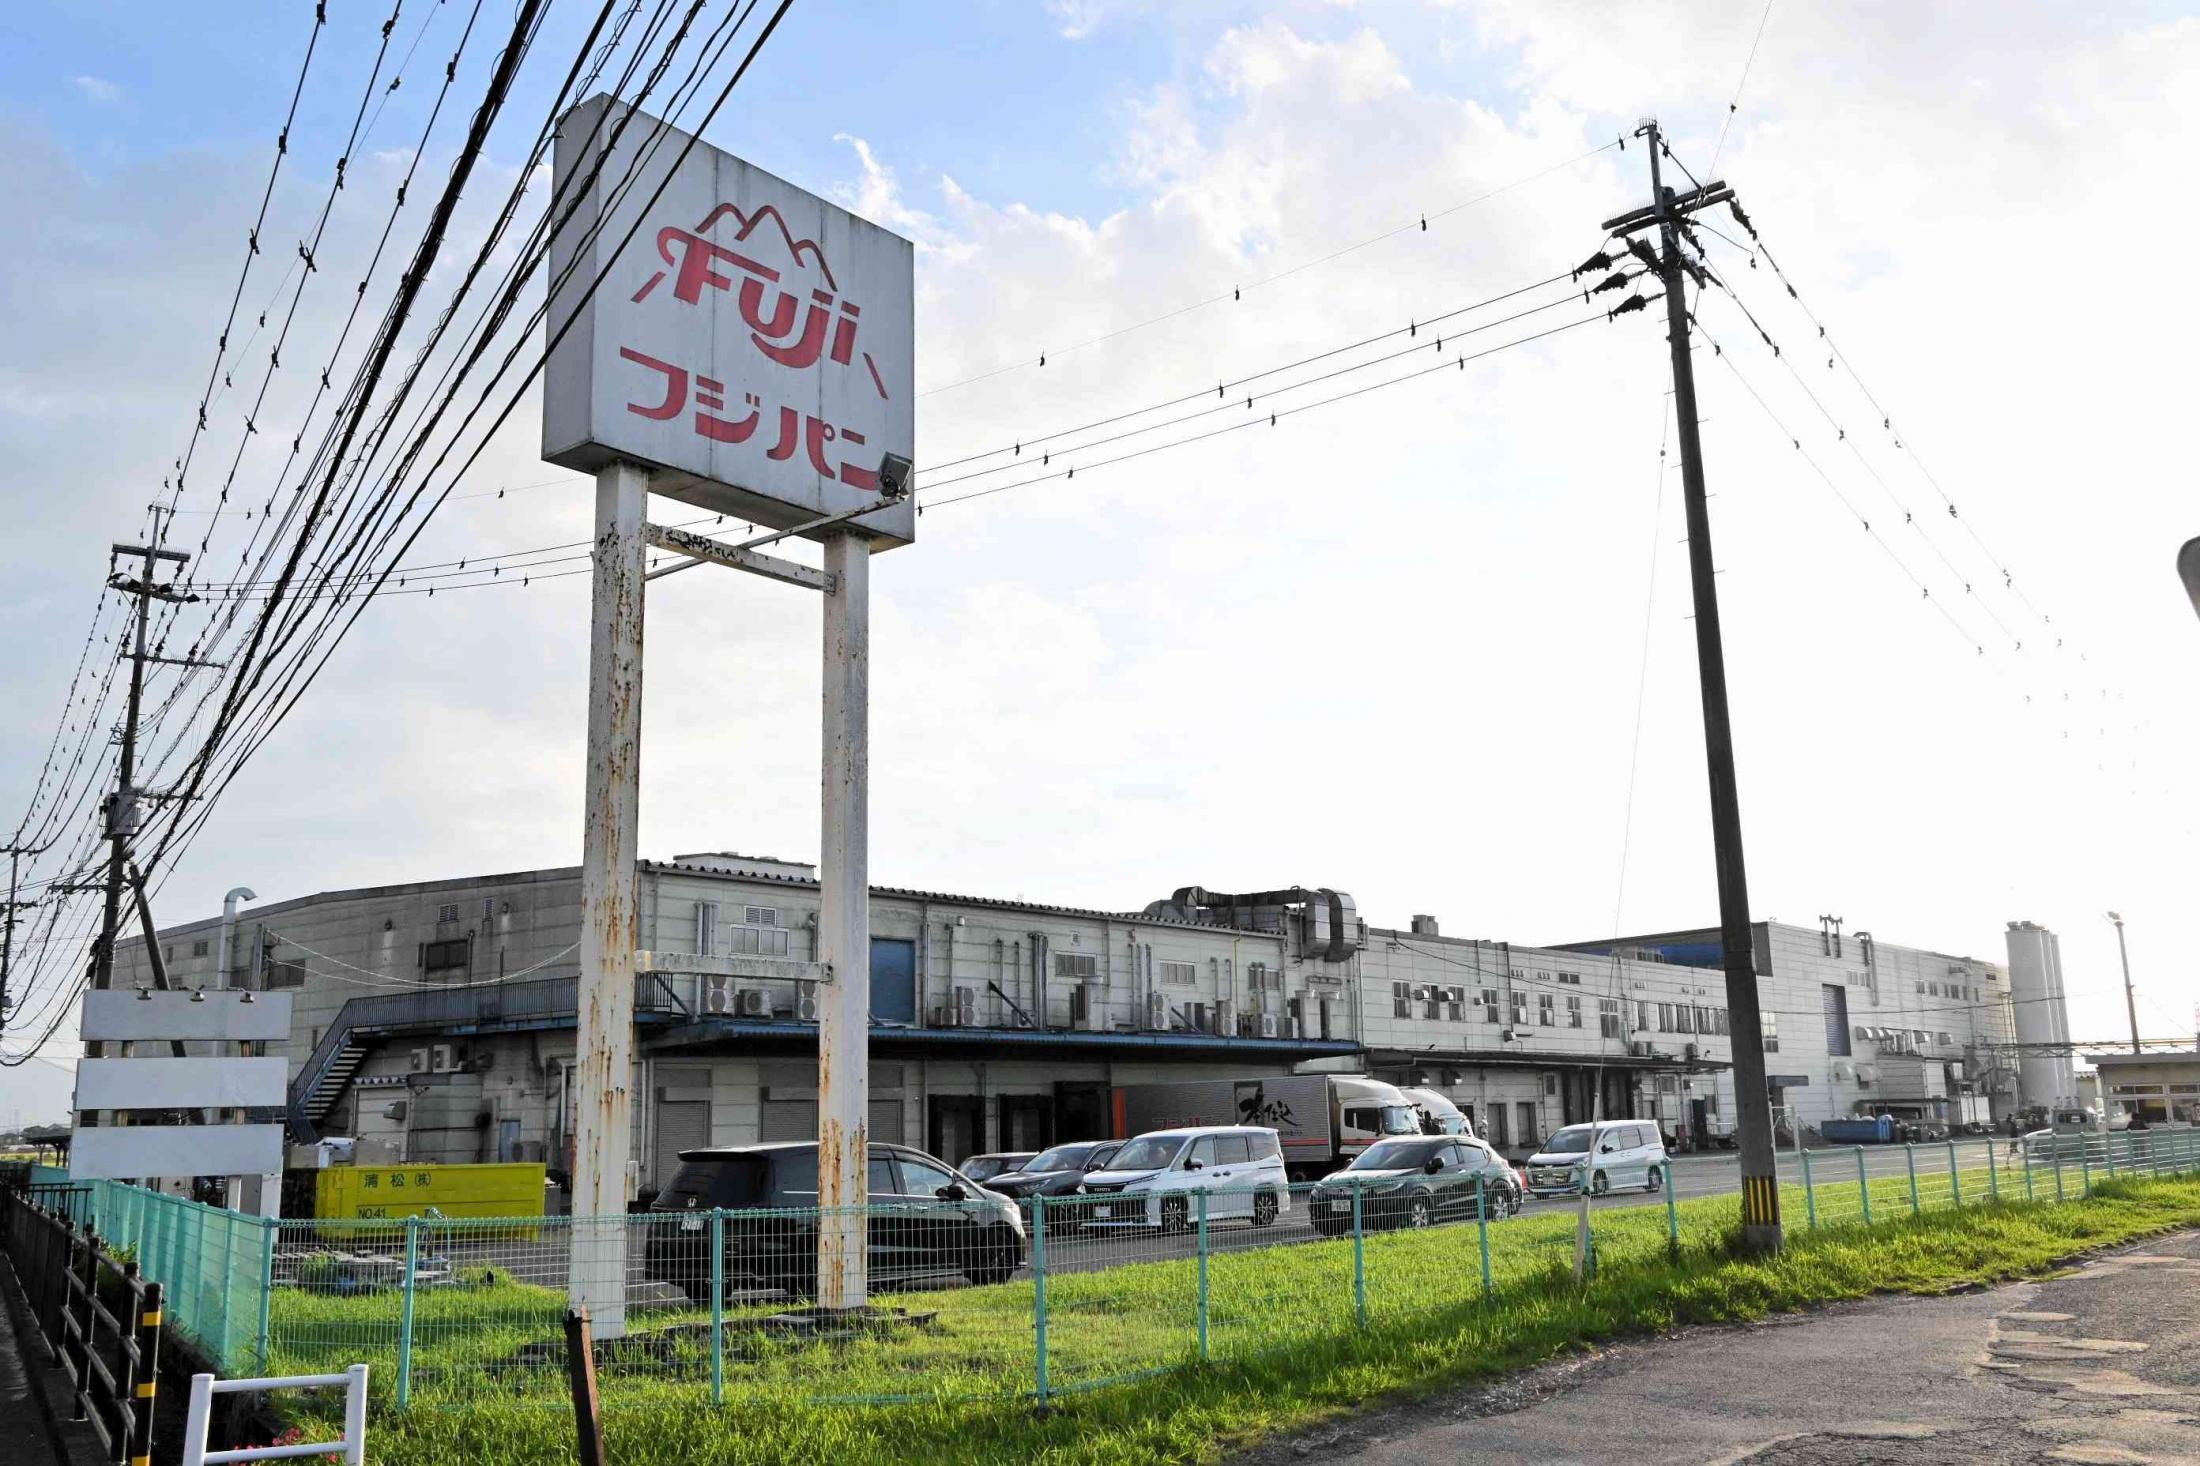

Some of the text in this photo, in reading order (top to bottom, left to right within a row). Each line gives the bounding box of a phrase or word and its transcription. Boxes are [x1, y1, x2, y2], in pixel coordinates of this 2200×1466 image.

[657, 225, 860, 369] Fuji
[620, 345, 881, 491] フジパン
